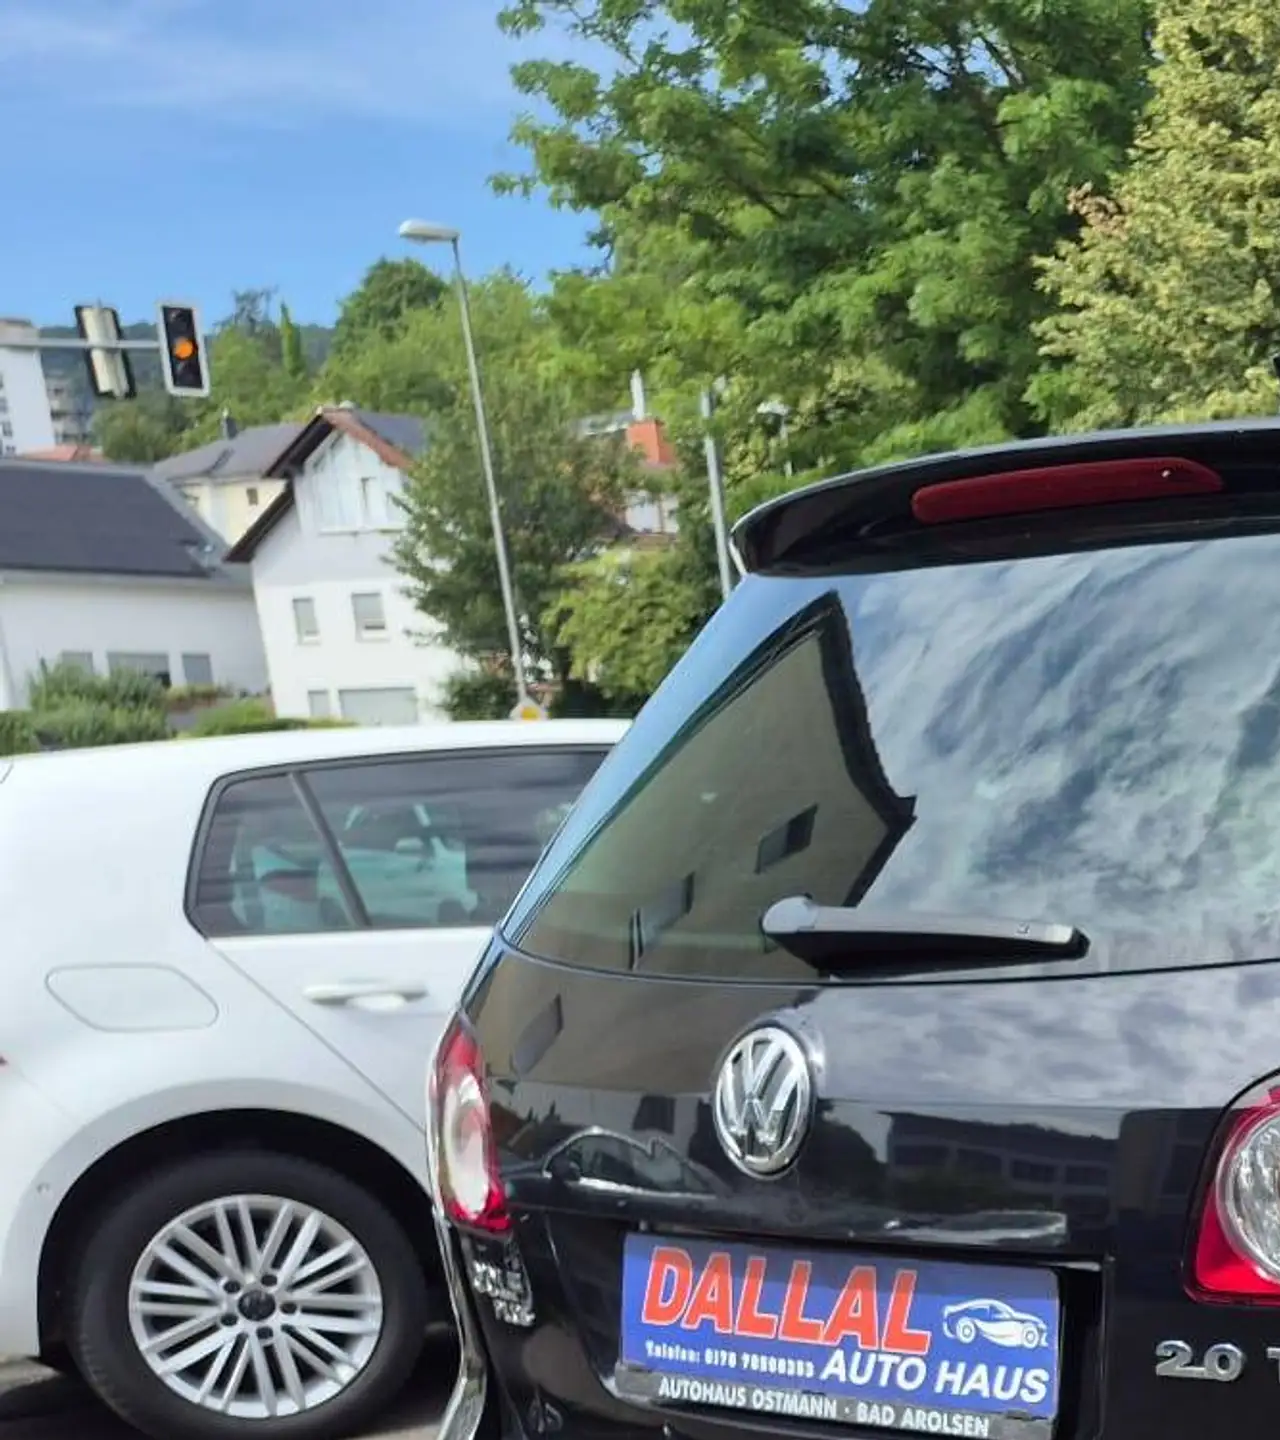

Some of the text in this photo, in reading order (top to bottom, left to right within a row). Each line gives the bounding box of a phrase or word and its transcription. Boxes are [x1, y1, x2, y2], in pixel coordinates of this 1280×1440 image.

[641, 1245, 931, 1354] DALLAL
[658, 1376, 990, 1437] AUTOHAUS OSTMANN BAD AROLSEN
[820, 1349, 1050, 1404] AUTO HAUS
